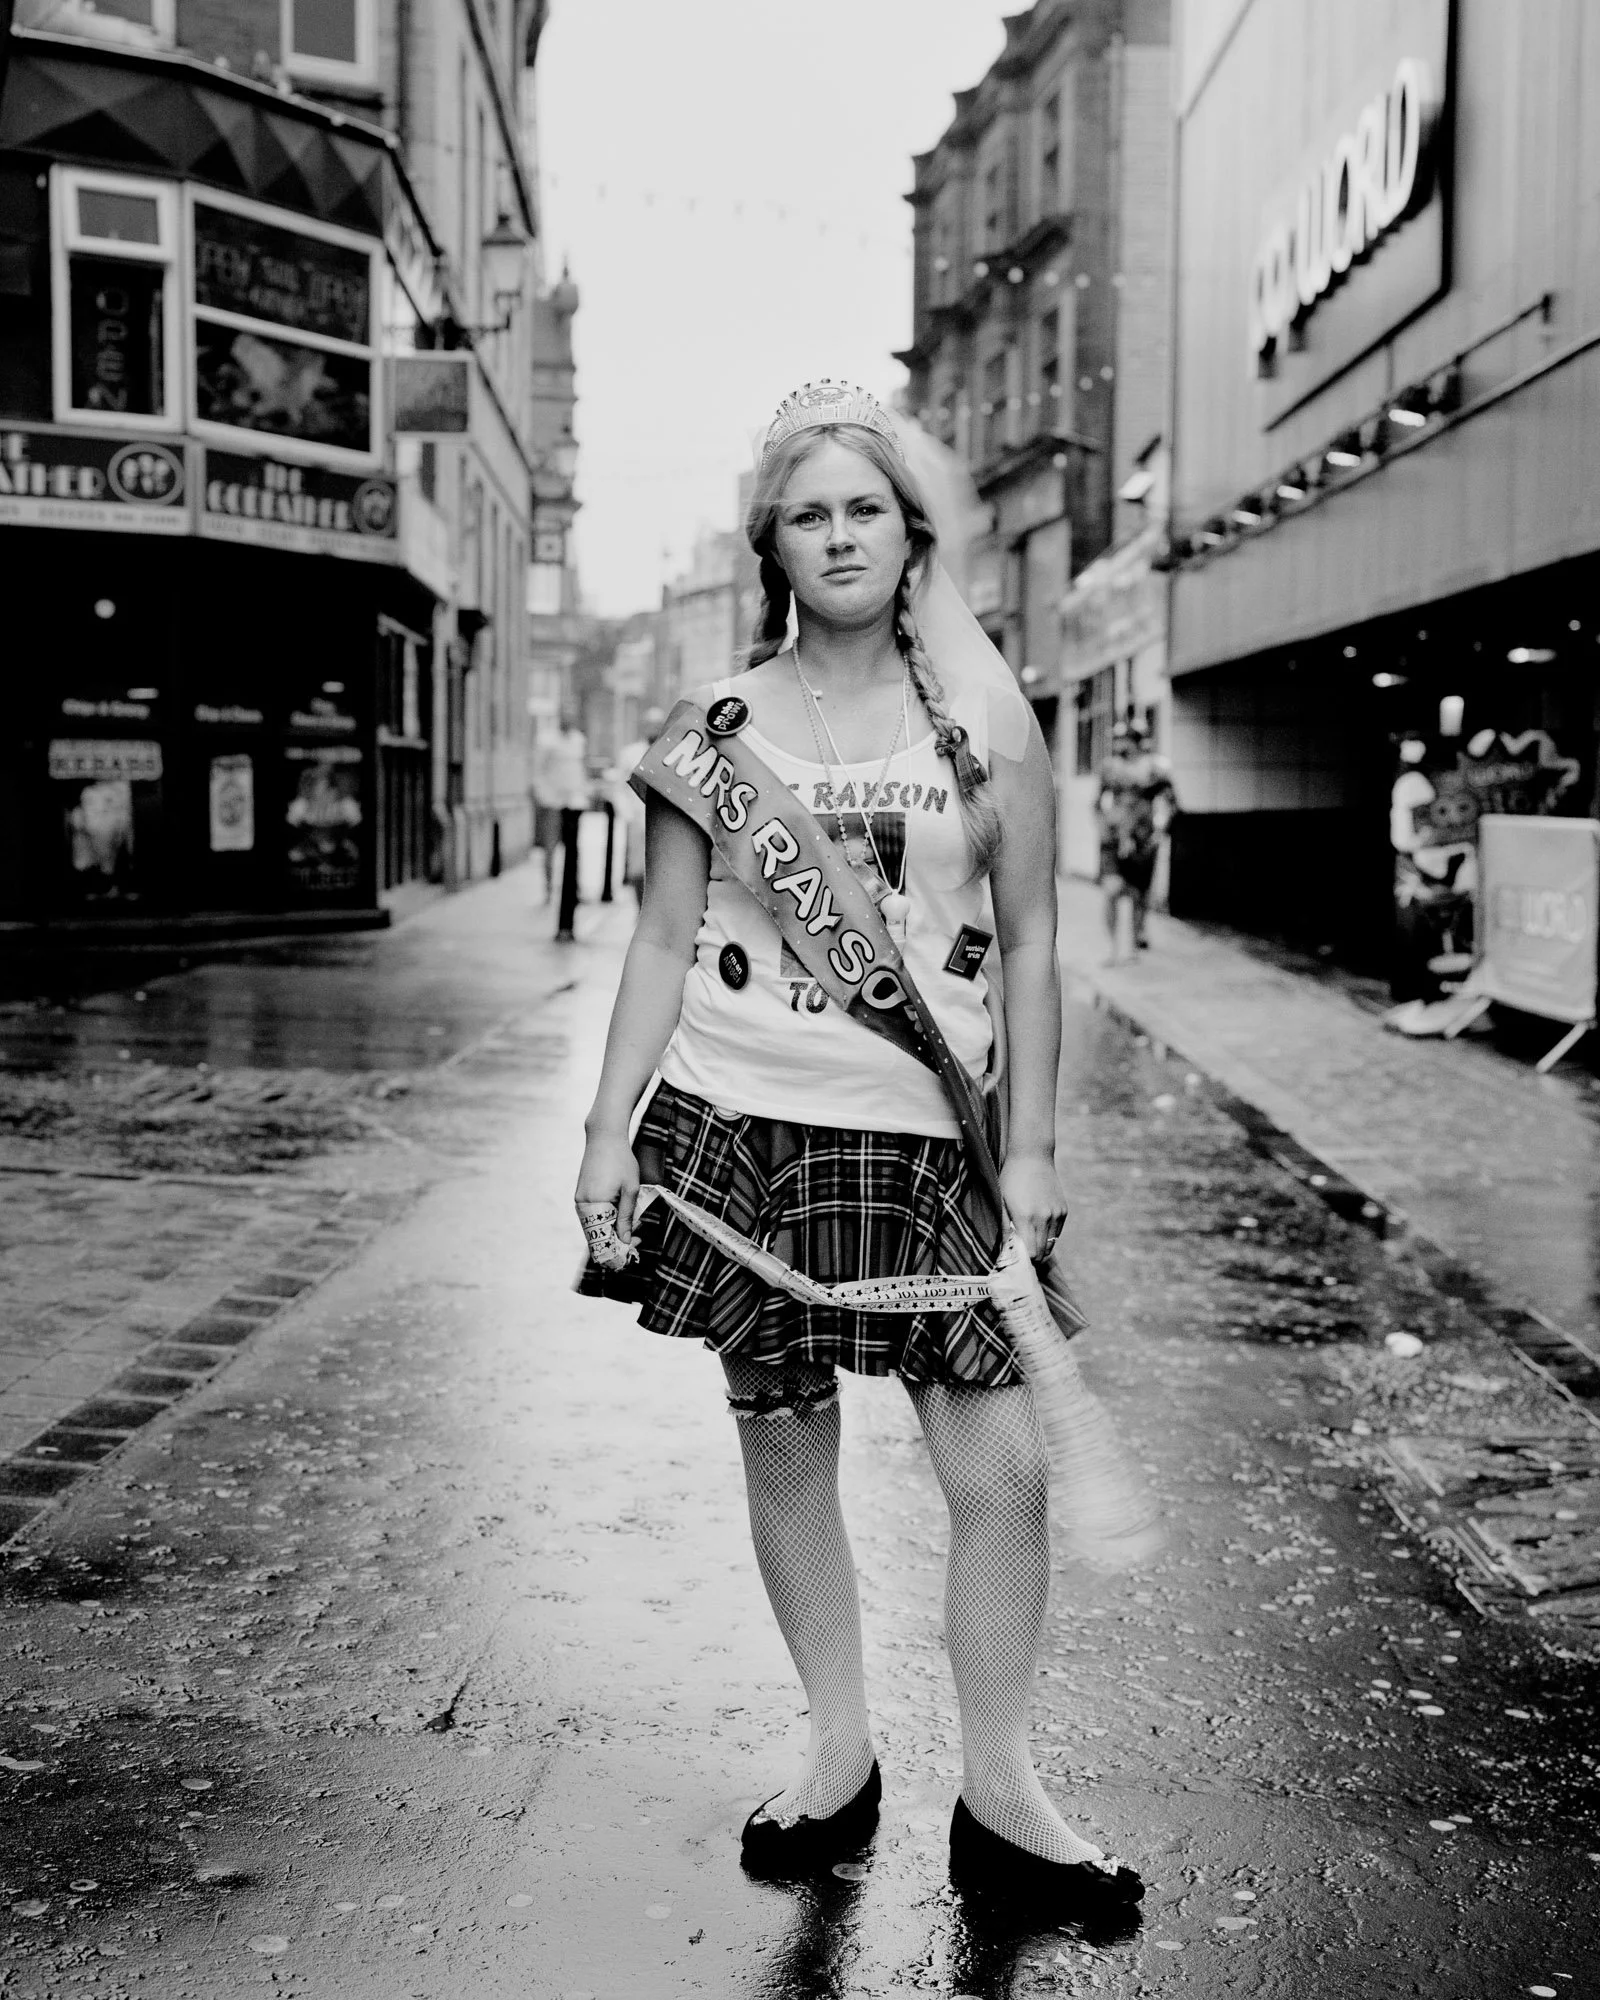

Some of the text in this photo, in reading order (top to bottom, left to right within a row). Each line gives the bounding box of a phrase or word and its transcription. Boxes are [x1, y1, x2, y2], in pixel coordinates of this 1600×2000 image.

[713, 701, 734, 725] on the
[813, 781, 948, 814] RAYSON
[662, 729, 916, 1016] MRS RAYSO
[789, 981, 830, 1014] TO
[922, 1288, 947, 1298] GOT
